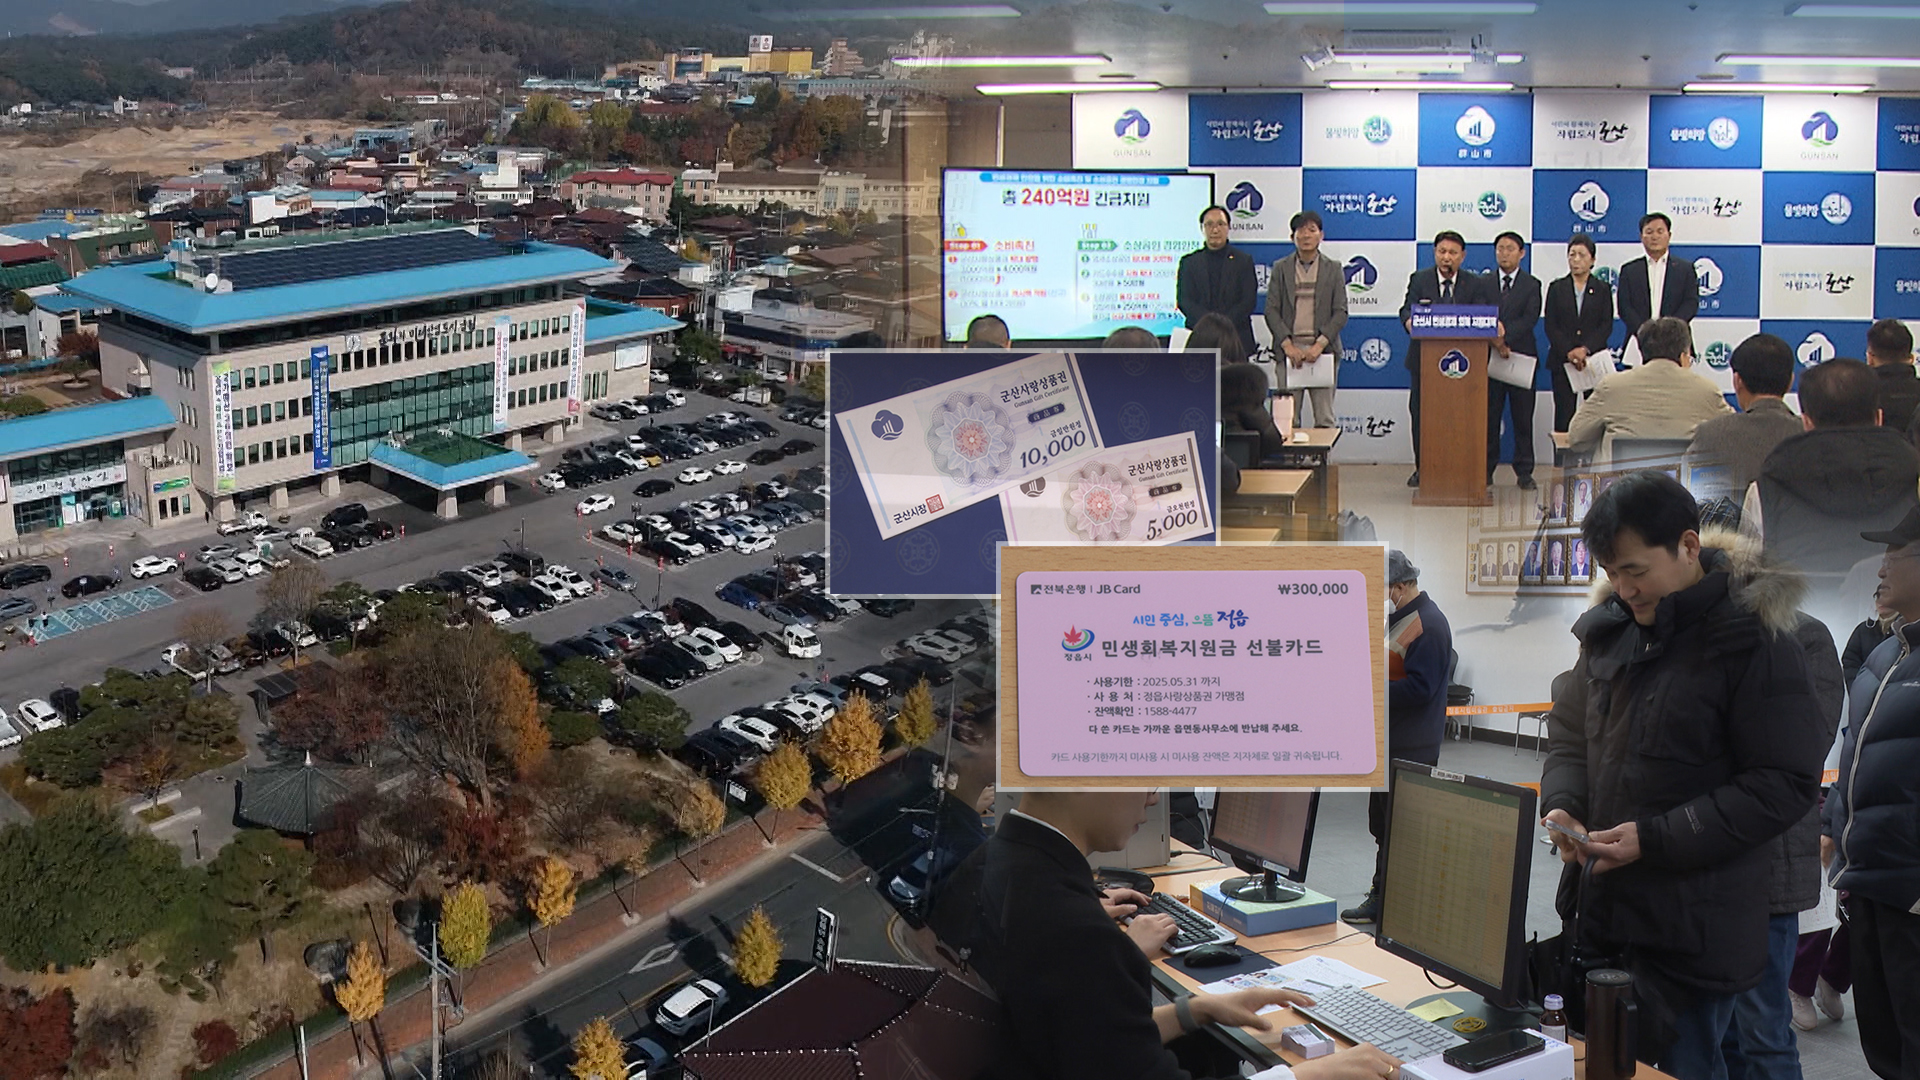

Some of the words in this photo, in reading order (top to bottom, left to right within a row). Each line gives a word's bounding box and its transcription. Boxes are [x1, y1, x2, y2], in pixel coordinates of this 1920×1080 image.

[1557, 129, 1597, 140] 자립도시
[1113, 149, 1151, 158] GUNSAN
[1801, 151, 1839, 160] GUNSAN
[1021, 188, 1090, 207] 240억원
[1095, 191, 1150, 207] 긴급지원
[1324, 202, 1365, 213] 자립도시
[1231, 223, 1264, 231] UNSAN
[994, 240, 1035, 252] 소비촉진
[1000, 370, 1069, 404] 군산사랑상품권
[1014, 398, 1034, 409] Gunsan
[1034, 393, 1045, 403] Gift
[1044, 385, 1071, 399] Certificate
[1050, 420, 1082, 439] 금일만원정
[1020, 430, 1086, 469] 10,000
[1128, 453, 1188, 477] 군산사랑상품권
[1165, 467, 1189, 477] Certificate
[1166, 500, 1196, 514] 금오천원정
[893, 503, 928, 525] 군산시장
[1146, 509, 1198, 541] 5,000
[1043, 584, 1087, 595] 전북은행
[1096, 584, 1112, 594] JB
[1113, 583, 1141, 595] Card
[1277, 582, 1349, 597] ₩300,000
[1132, 614, 1156, 627] 시민
[1159, 612, 1190, 628] 중심,
[1191, 613, 1214, 627] 으뜸
[1216, 609, 1250, 630] 정읍
[1101, 639, 1237, 658] 민생회복지원금
[1246, 638, 1324, 657] 선불카드
[1064, 652, 1092, 662] 정읍시
[1093, 676, 1134, 688] 사용기한
[1142, 676, 1197, 687] 2025.05.31
[1200, 676, 1221, 687] 까지
[1143, 691, 1213, 702] 정읍사랑상품권
[1215, 690, 1245, 702] 가맹점
[1094, 706, 1134, 717] 잔액확인
[1144, 706, 1198, 717] 1588-4477
[1088, 724, 1098, 735] 다
[1100, 724, 1110, 735] 쓴
[1113, 724, 1141, 735] 카드는
[1144, 724, 1171, 735] 가까운
[1173, 723, 1239, 735] 읍면동사무소에
[1241, 723, 1270, 734] 반납해
[1271, 723, 1304, 734] 주세요.
[1051, 752, 1070, 763] 카드
[1071, 752, 1128, 763] 사용기한까지
[1129, 751, 1158, 763] 미사용
[1160, 752, 1170, 762] 시
[1171, 751, 1201, 763] 미사용
[1202, 751, 1231, 762] 잔액은
[1232, 751, 1270, 762] 지자체로
[1271, 750, 1292, 762] 일괄
[1293, 750, 1344, 762] 귀속됩니다.
